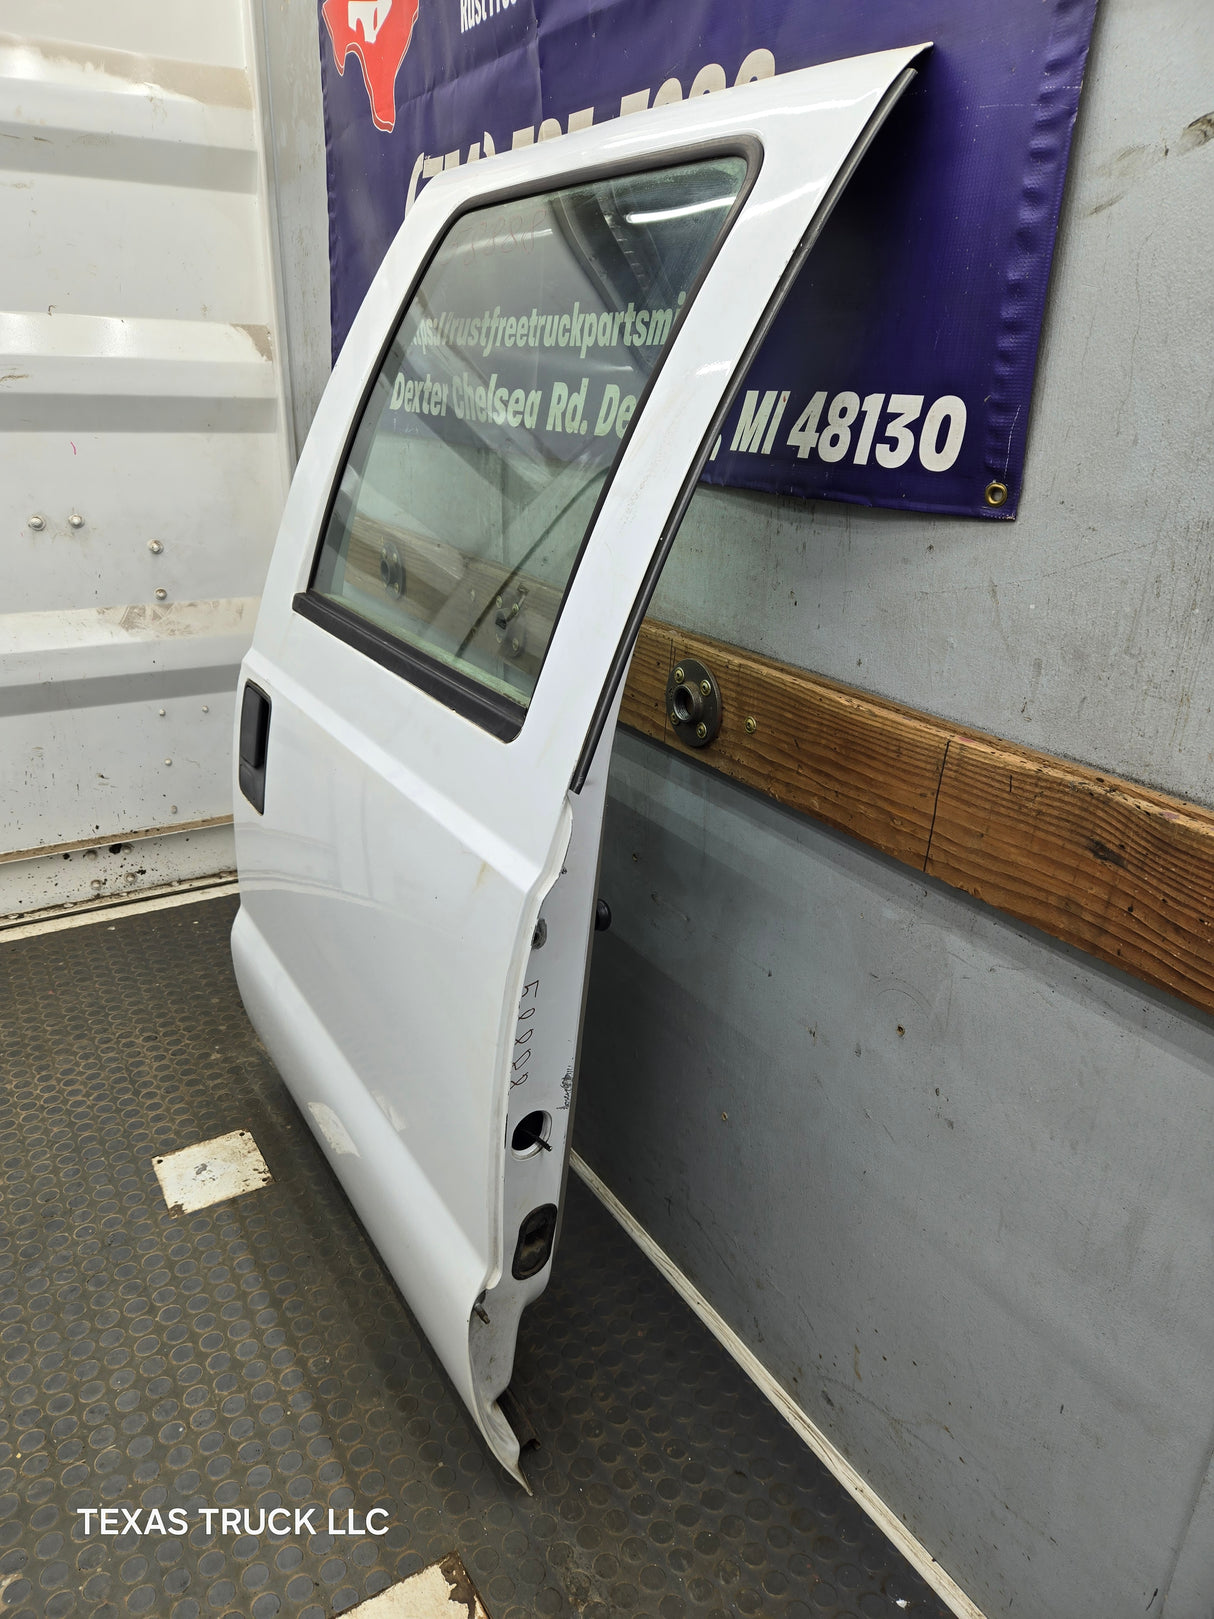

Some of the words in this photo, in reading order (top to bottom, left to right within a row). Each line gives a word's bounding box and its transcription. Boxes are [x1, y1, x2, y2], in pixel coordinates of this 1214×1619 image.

[389, 372, 449, 418] Dexter
[452, 372, 542, 429] Chelsea
[546, 378, 589, 435] Rd.
[730, 390, 791, 455] MI
[786, 391, 967, 472] 48130
